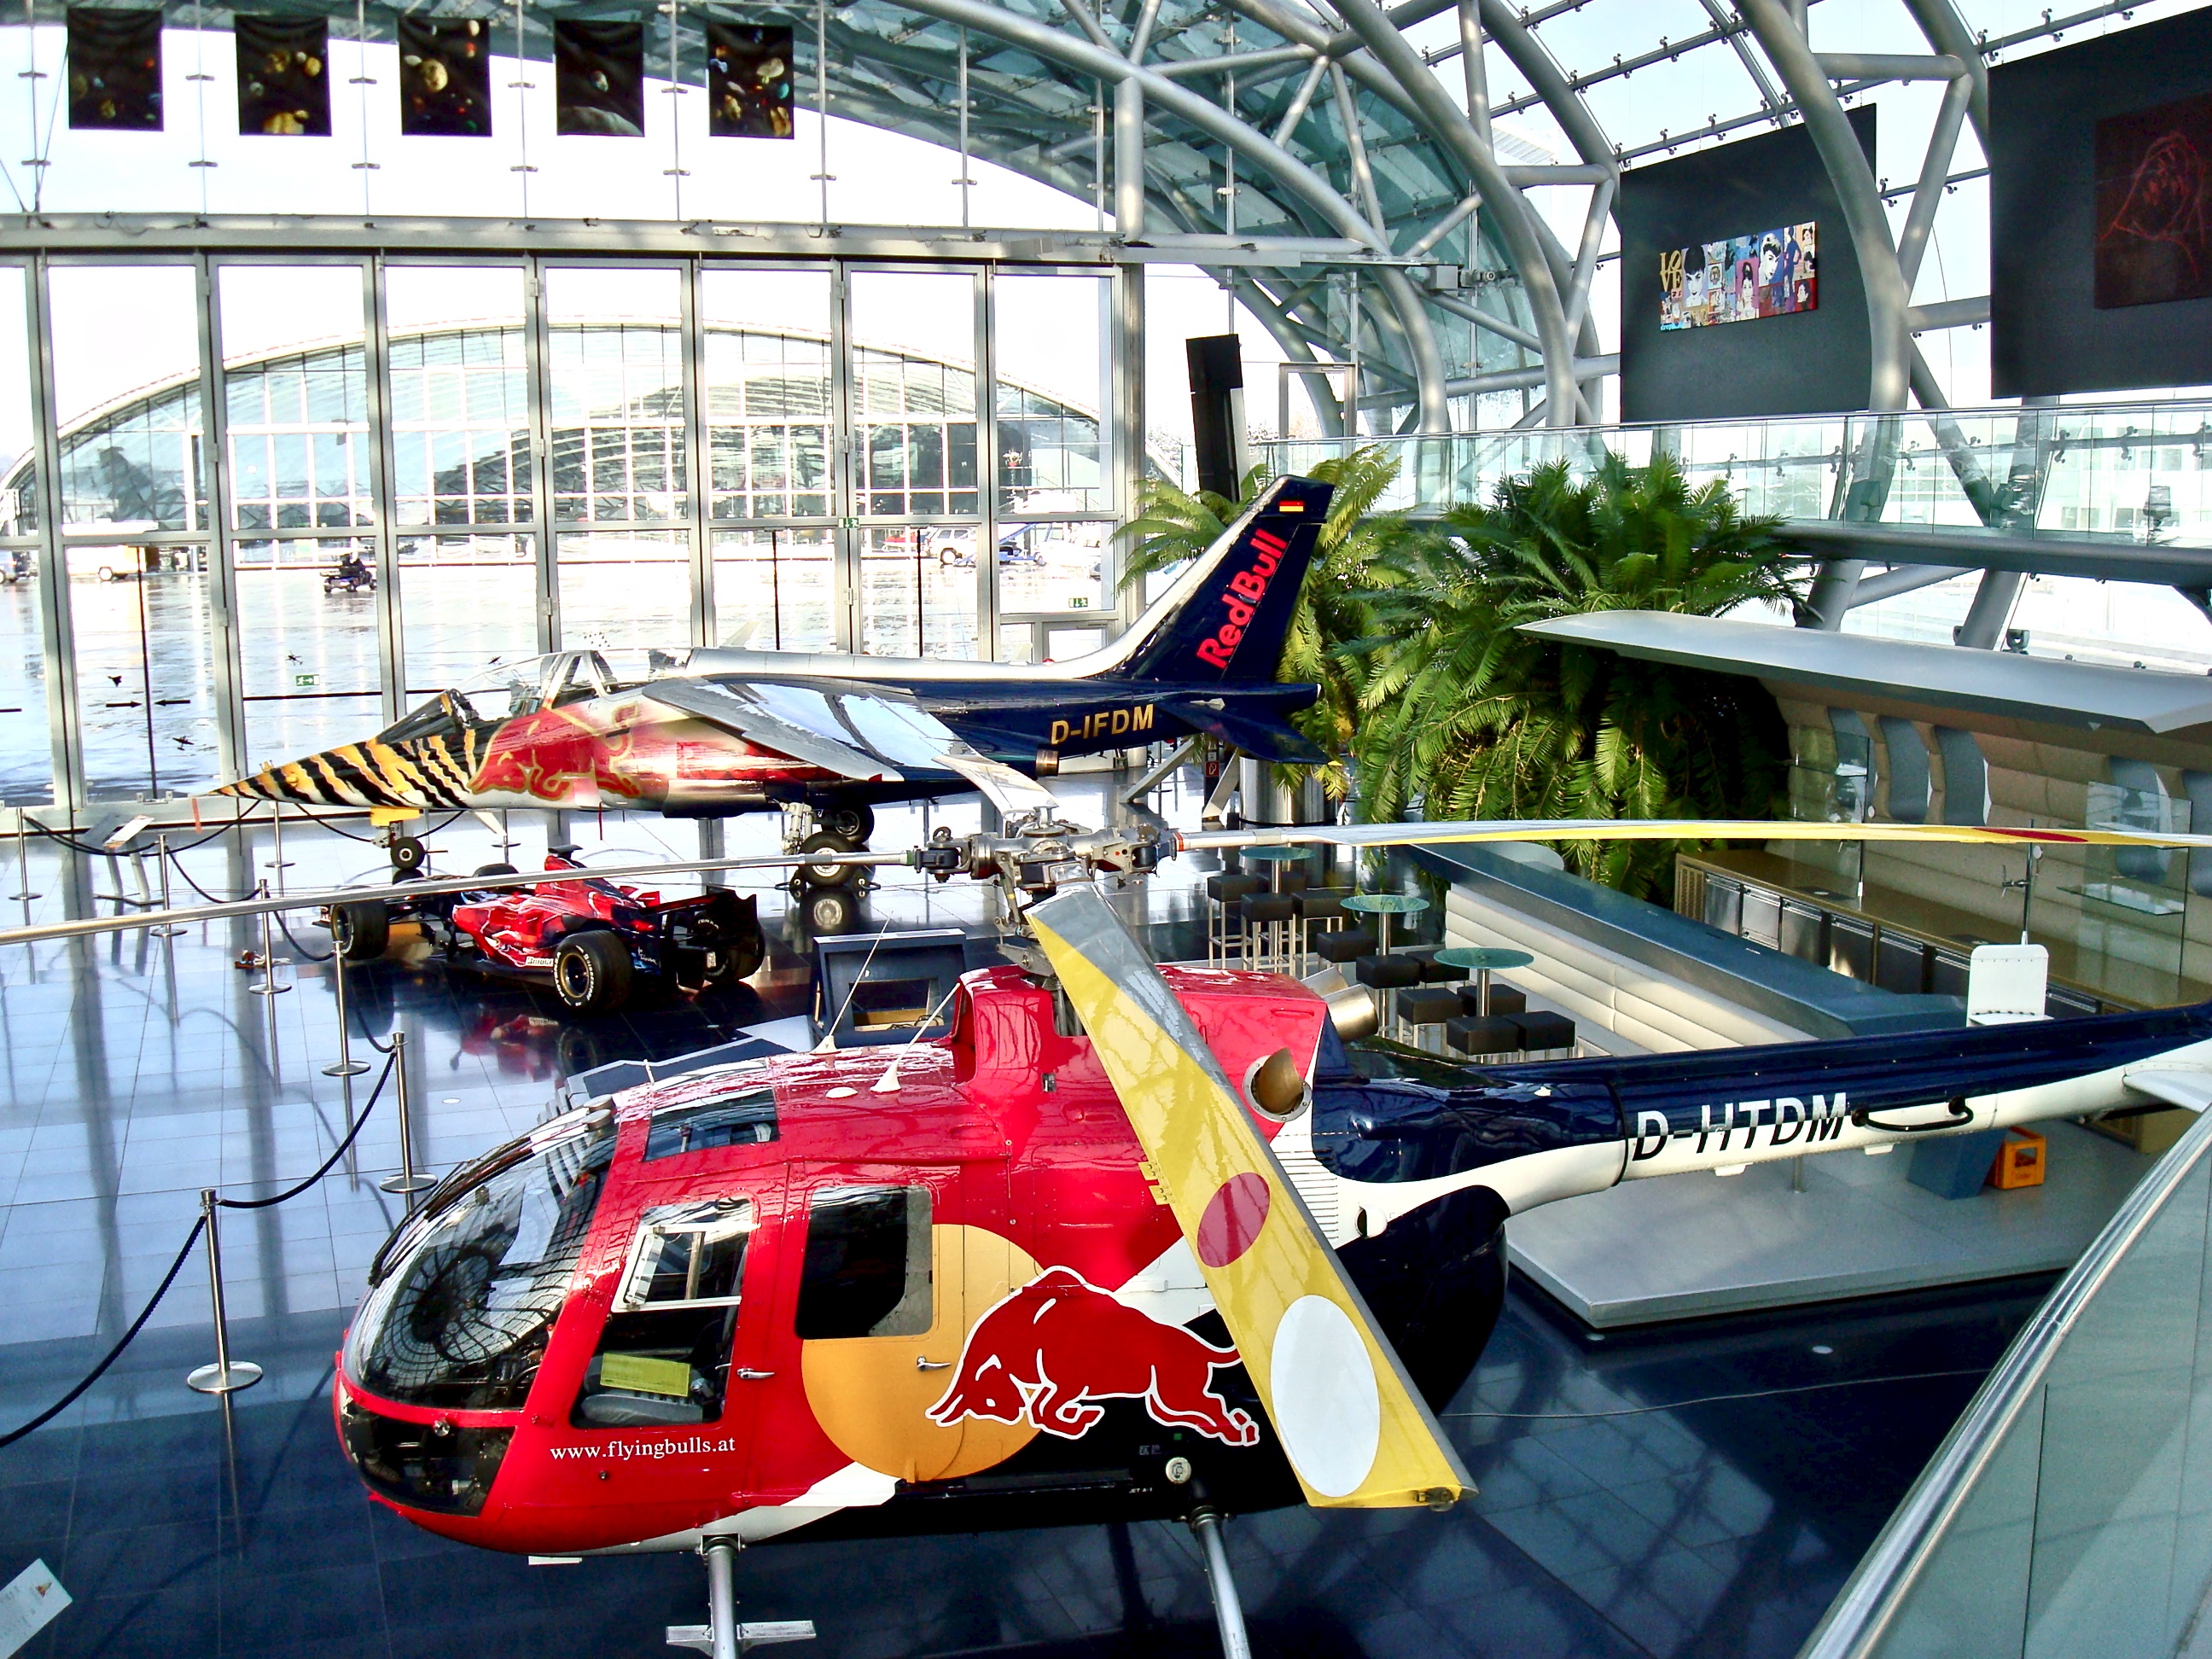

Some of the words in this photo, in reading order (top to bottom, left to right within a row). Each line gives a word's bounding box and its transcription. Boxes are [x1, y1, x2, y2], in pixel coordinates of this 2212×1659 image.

[1051, 703, 1154, 745] D-IFDM
[1632, 1092, 1846, 1161] D-HTDM
[550, 1437, 736, 1460] www.flyingbulls.at
